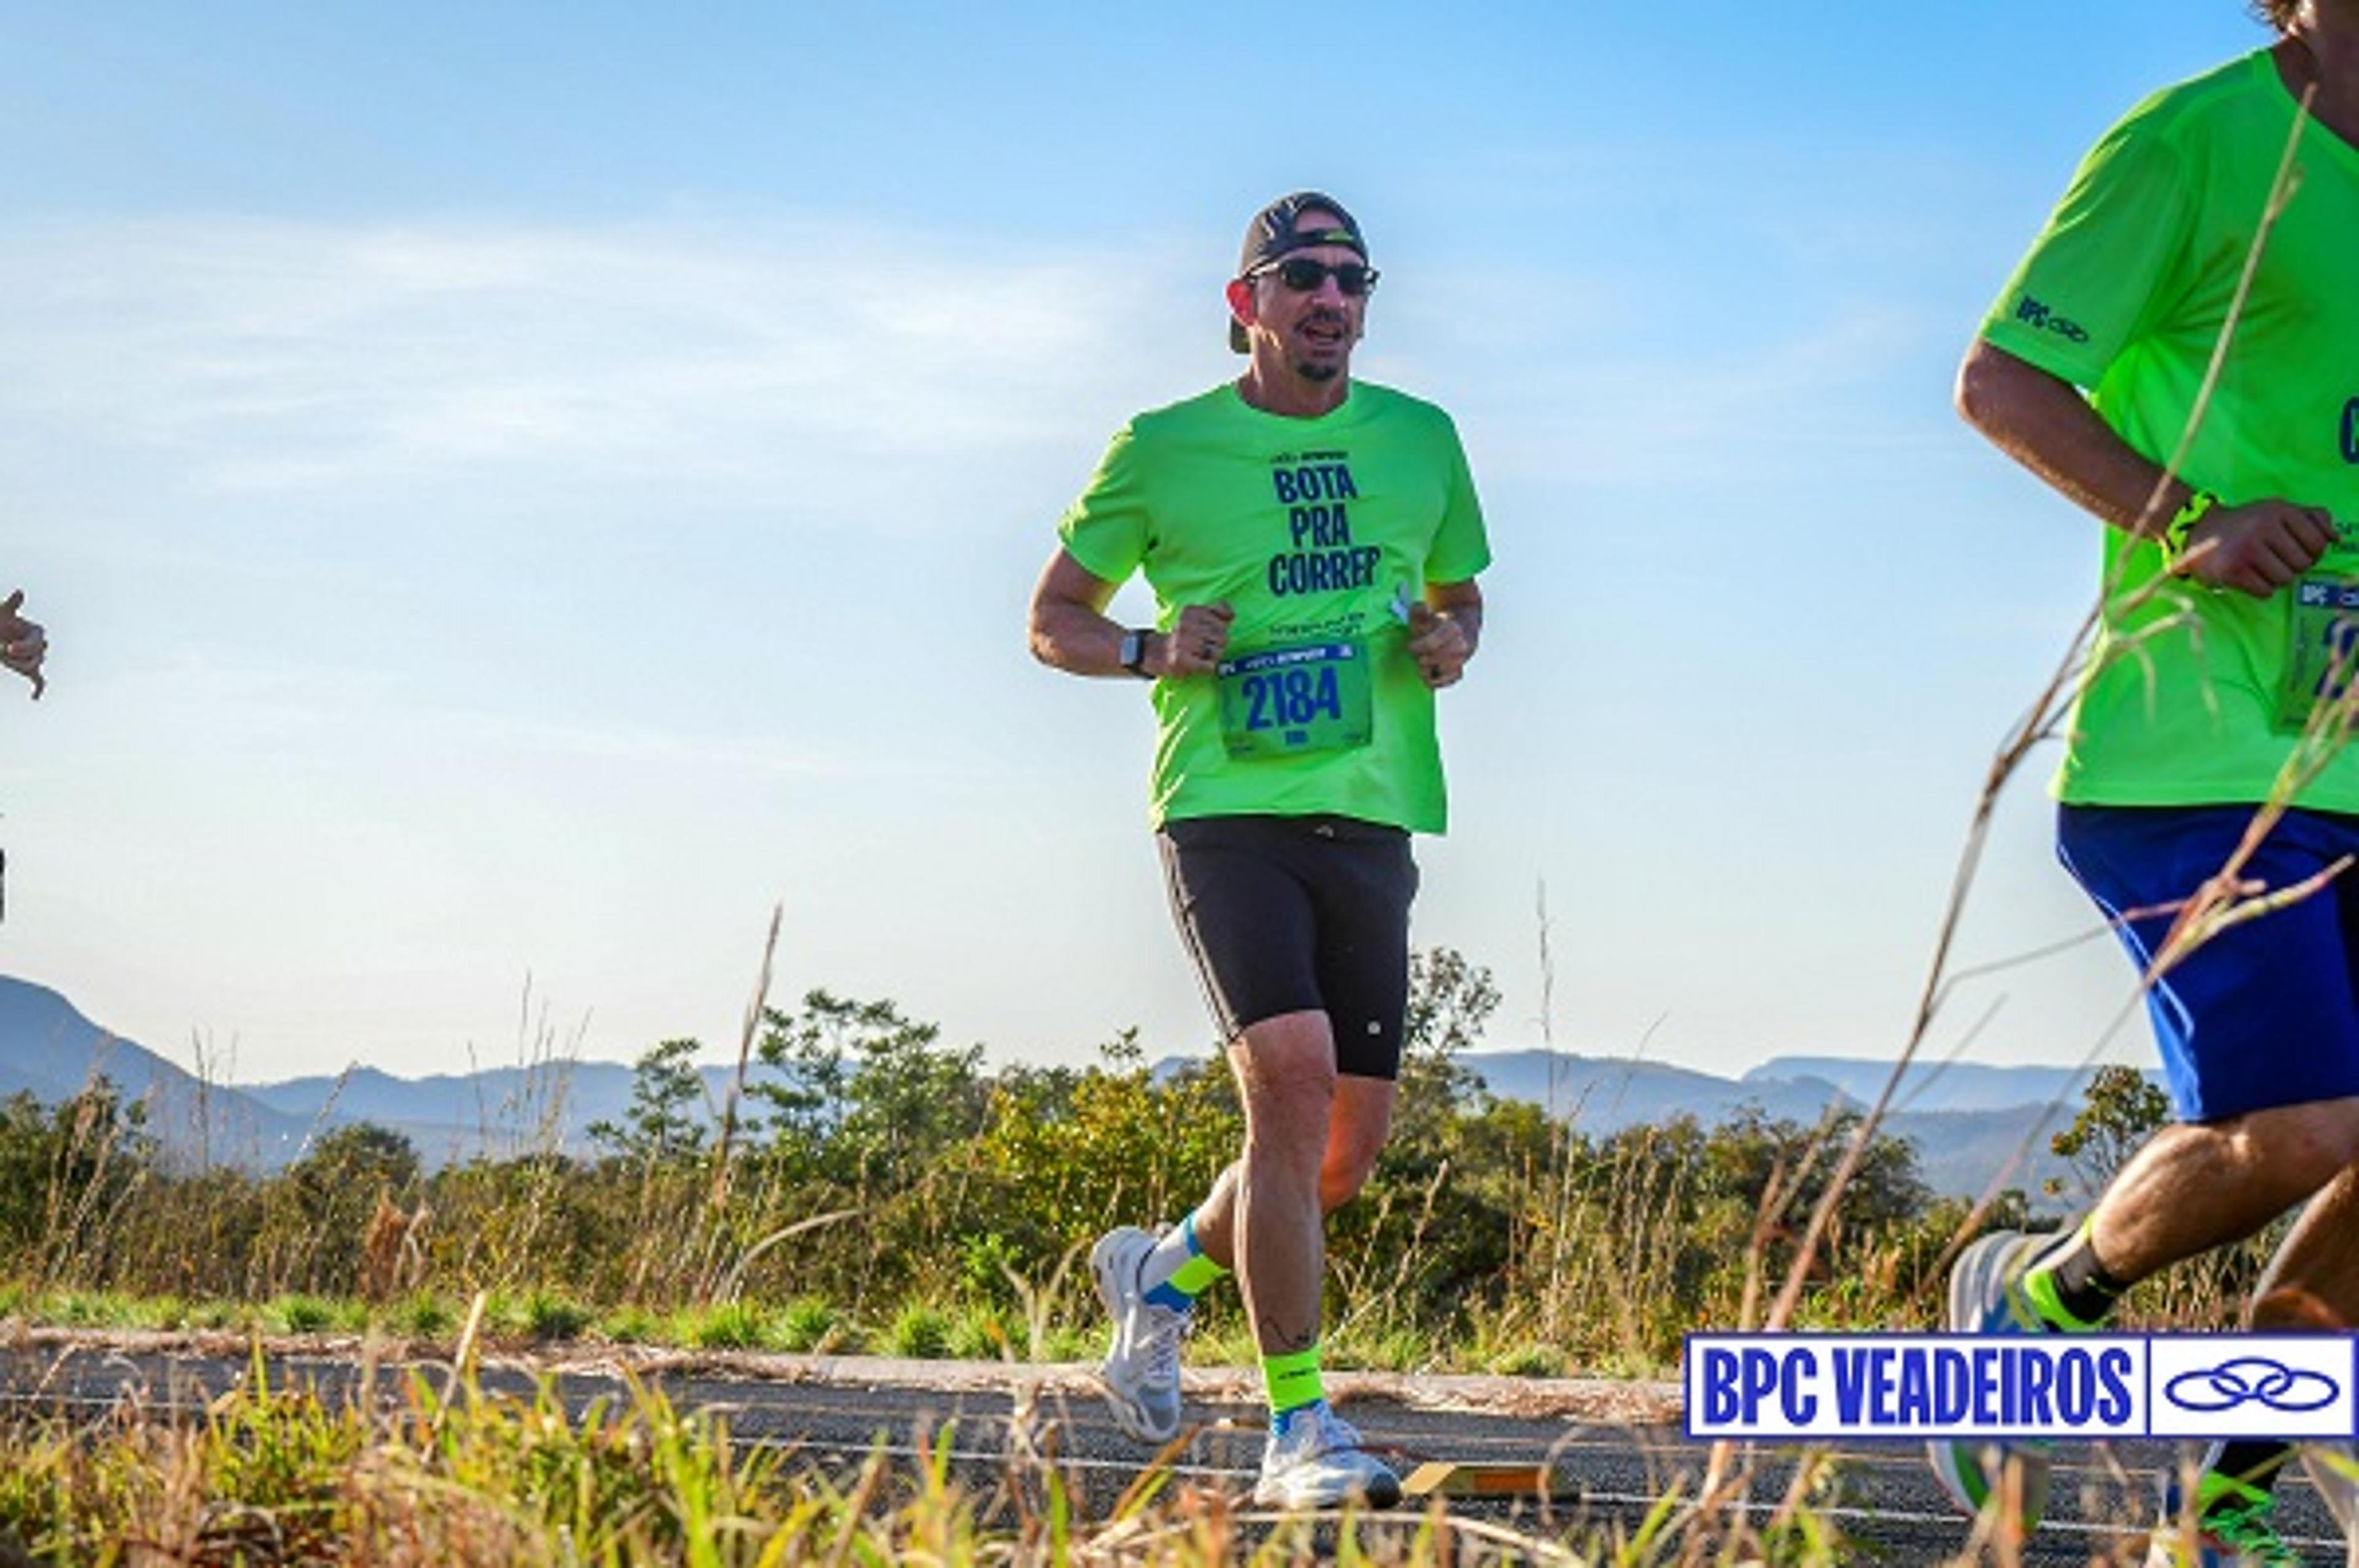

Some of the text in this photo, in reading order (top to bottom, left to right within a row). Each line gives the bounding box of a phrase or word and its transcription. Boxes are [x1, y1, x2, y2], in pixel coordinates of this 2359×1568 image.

[1274, 465, 1358, 504] BOTA
[1290, 504, 1350, 547] PRA
[1242, 667, 1341, 731] 2184
